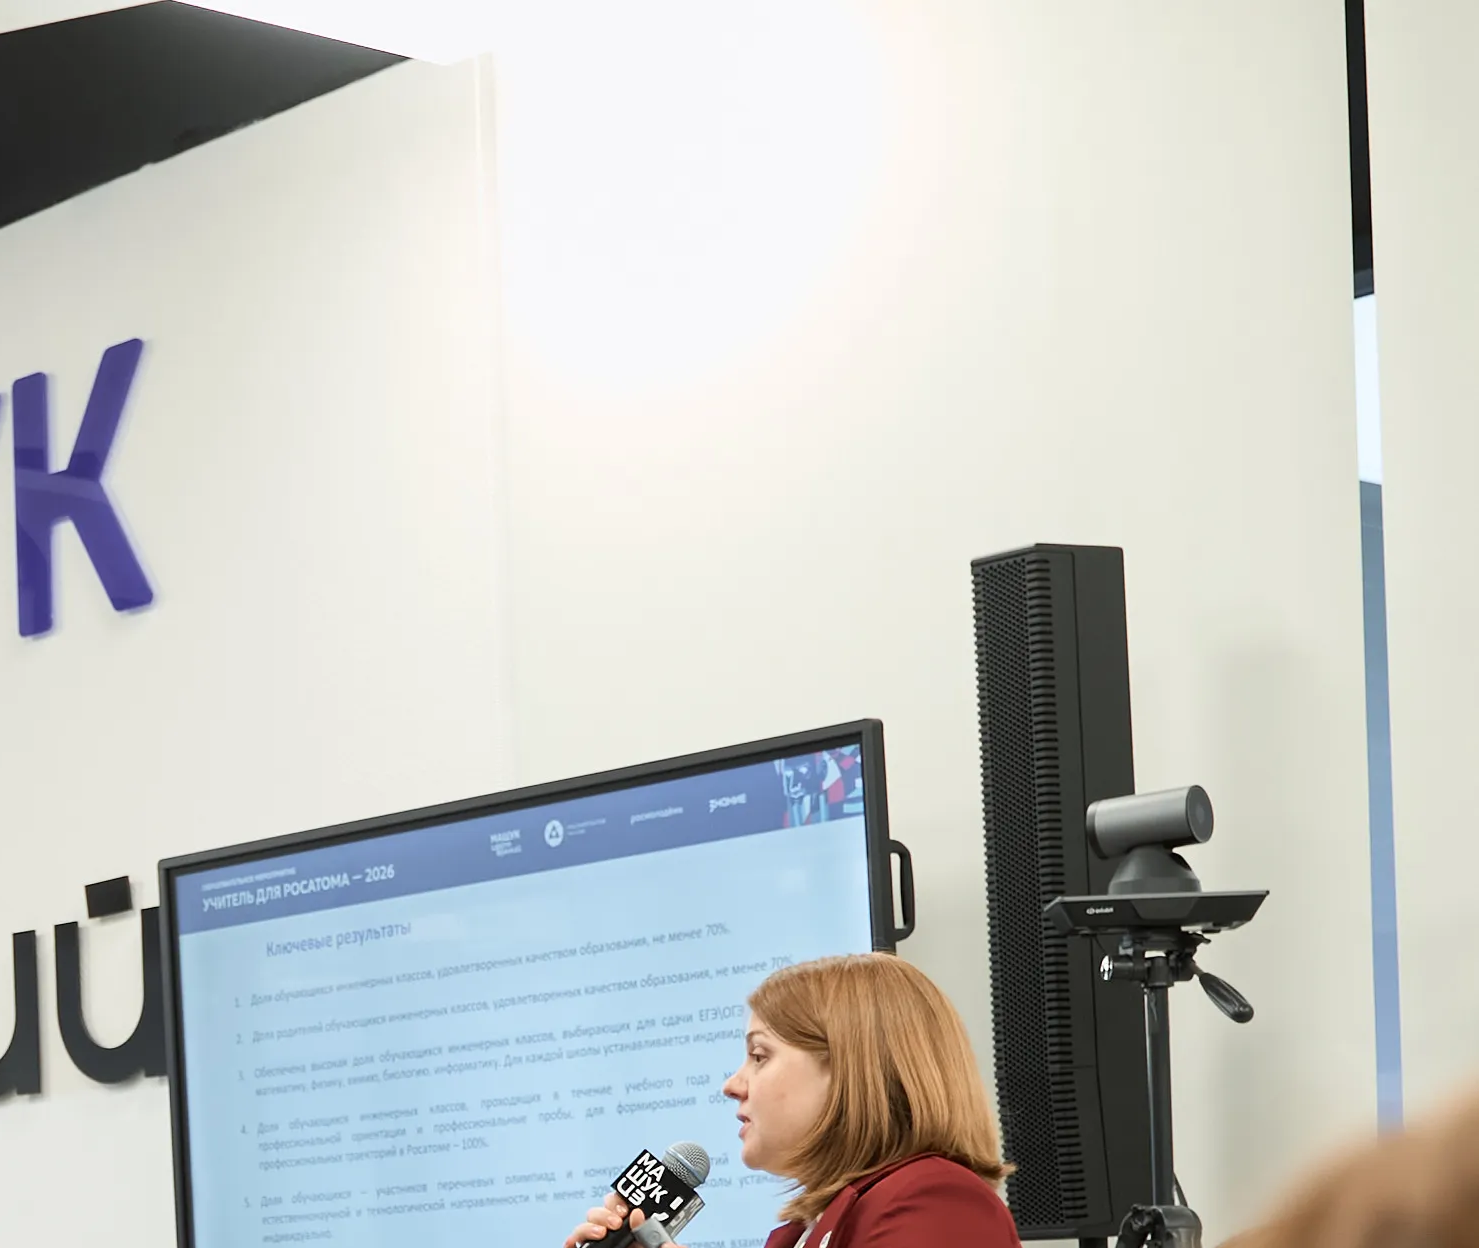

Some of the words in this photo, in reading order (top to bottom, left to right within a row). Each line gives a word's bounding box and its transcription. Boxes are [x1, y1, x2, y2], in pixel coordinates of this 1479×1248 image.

[202, 889, 254, 913] УЧИТЕЛЬ
[255, 884, 282, 905] ДЛЯ
[282, 871, 350, 898] РОСАТОМА
[364, 863, 395, 883] 2026
[265, 931, 333, 958] Ключевые
[335, 921, 411, 949] результаты
[249, 992, 273, 1008] Доля
[273, 984, 334, 1004] обучающихся
[335, 974, 394, 994] инженерных
[436, 955, 523, 981] удовлетворенных
[524, 946, 578, 965] качеством
[578, 936, 650, 958] образования,
[651, 933, 667, 946] не
[667, 927, 703, 944] менее
[583, 978, 638, 997] качеством
[638, 969, 713, 990] образования,
[714, 965, 730, 979] не
[730, 960, 768, 977] менее
[378, 1045, 444, 1065] обучающихся
[561, 1020, 631, 1040] выбирающих
[634, 1017, 657, 1033] для
[660, 1012, 694, 1029] сдачи
[502, 1053, 523, 1069] Для
[524, 1046, 564, 1065] каждой
[564, 1045, 602, 1060] школы
[601, 1034, 691, 1058] устанавливается
[570, 1084, 613, 1100] течение
[623, 1077, 674, 1097] учебного
[684, 1073, 711, 1088] года
[584, 1105, 605, 1120] для
[614, 1095, 698, 1118] формирования
[405, 1141, 451, 1156] Росатоме
[625, 1165, 668, 1204] ШУК
[637, 1152, 665, 1182] МА
[534, 1191, 548, 1203] не
[551, 1188, 586, 1202] менее
